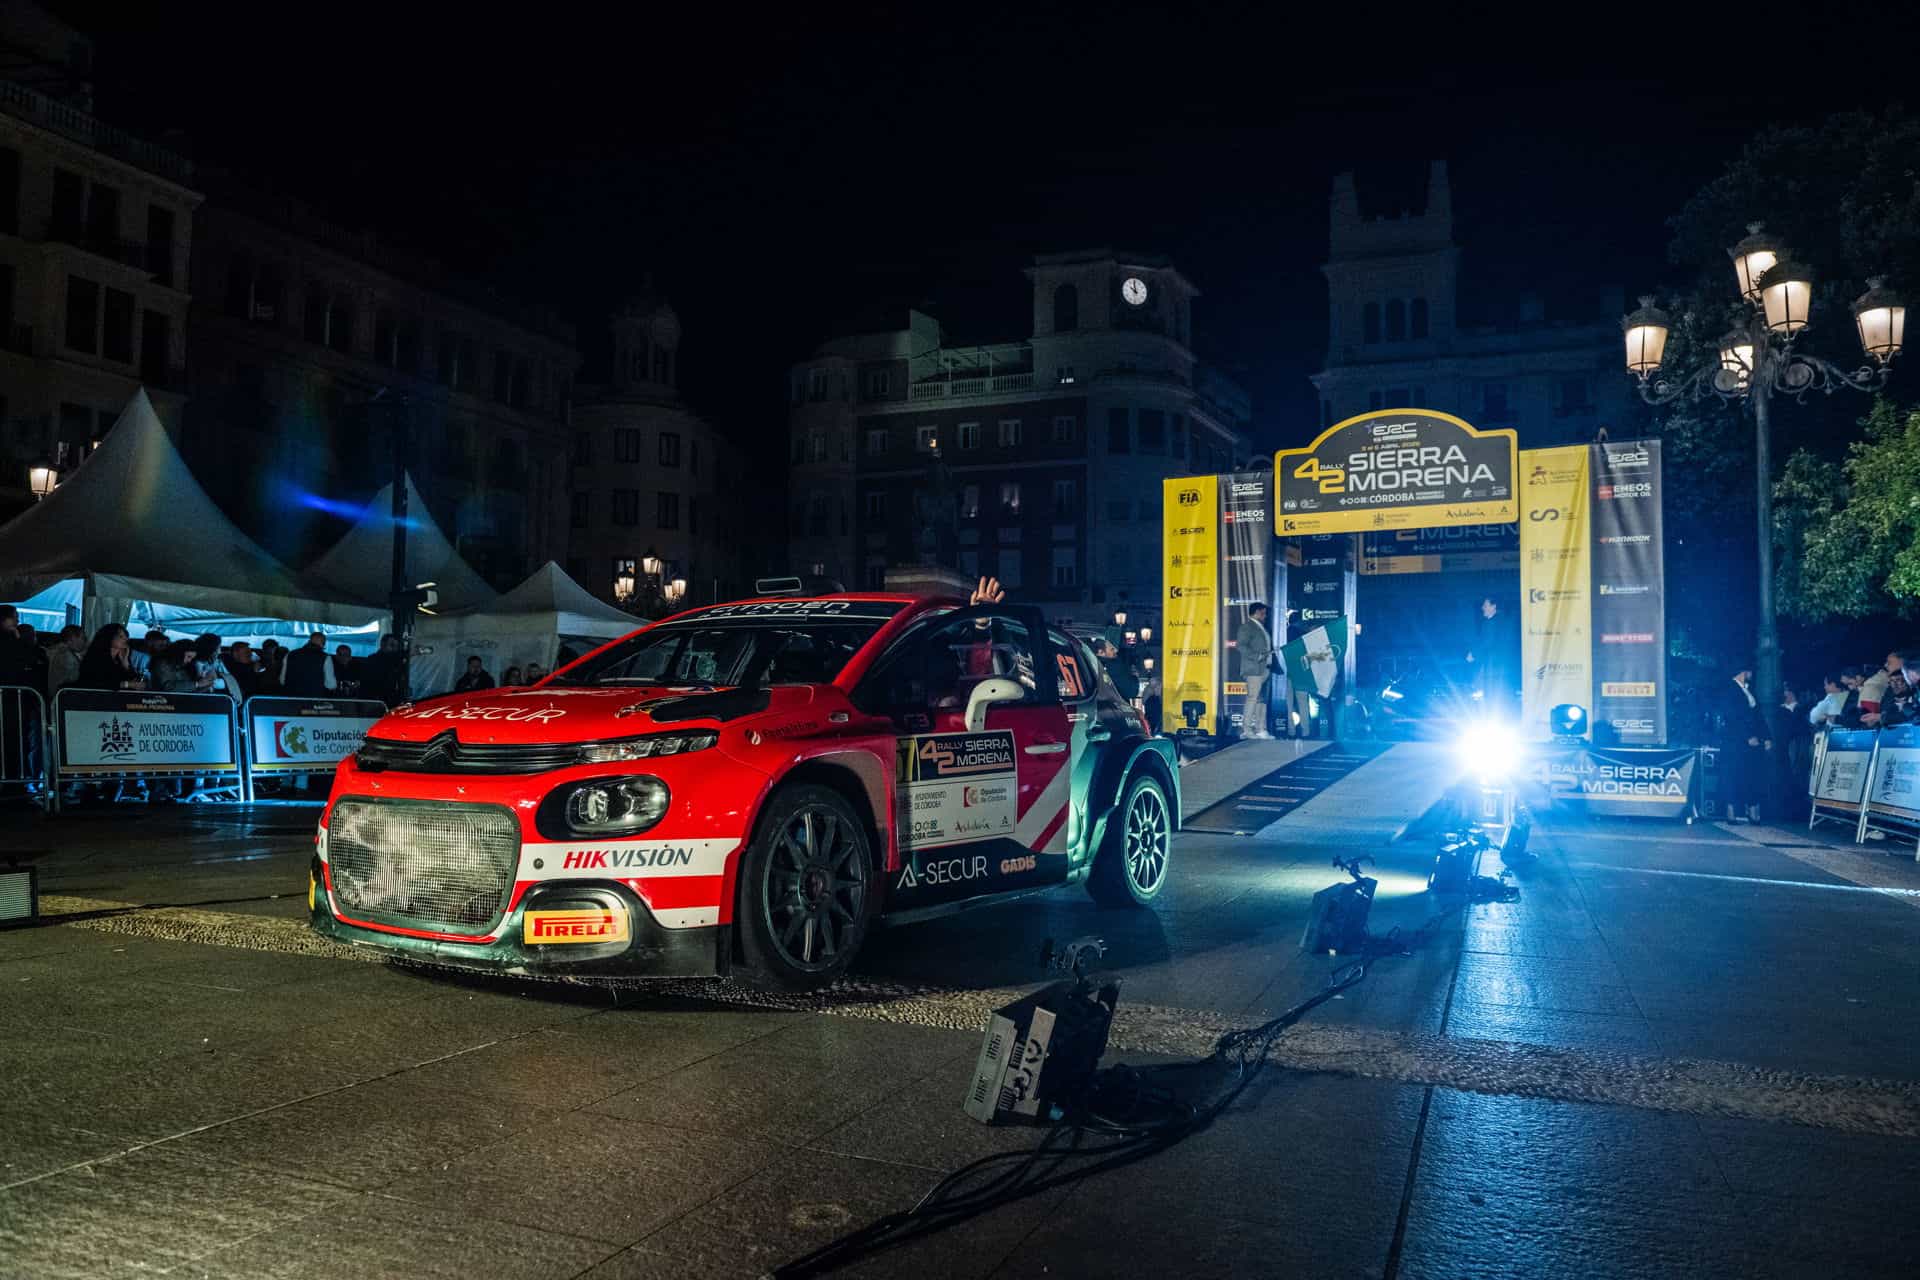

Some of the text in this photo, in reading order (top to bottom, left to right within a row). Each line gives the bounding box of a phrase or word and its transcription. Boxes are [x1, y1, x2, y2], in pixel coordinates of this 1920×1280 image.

[1349, 445, 1467, 472] SIERRA
[1349, 464, 1496, 492] MORENA
[1614, 483, 1651, 492] ENEOS
[1179, 493, 1199, 503] FIA
[1236, 510, 1264, 518] ENEOS
[139, 723, 205, 737] AYUNTAMIENTO
[139, 740, 151, 752] DE
[313, 744, 327, 754] de
[937, 738, 1010, 752] RALLY SIERRA
[957, 751, 1012, 767] MORENA
[1551, 764, 1681, 780] RALLY SIERRA
[1582, 781, 1682, 796] MORENA
[563, 848, 694, 869] HIKVISION
[1000, 855, 1037, 874] GADIS
[897, 855, 989, 889] A-SECUR
[534, 917, 617, 937] PIRELLI
